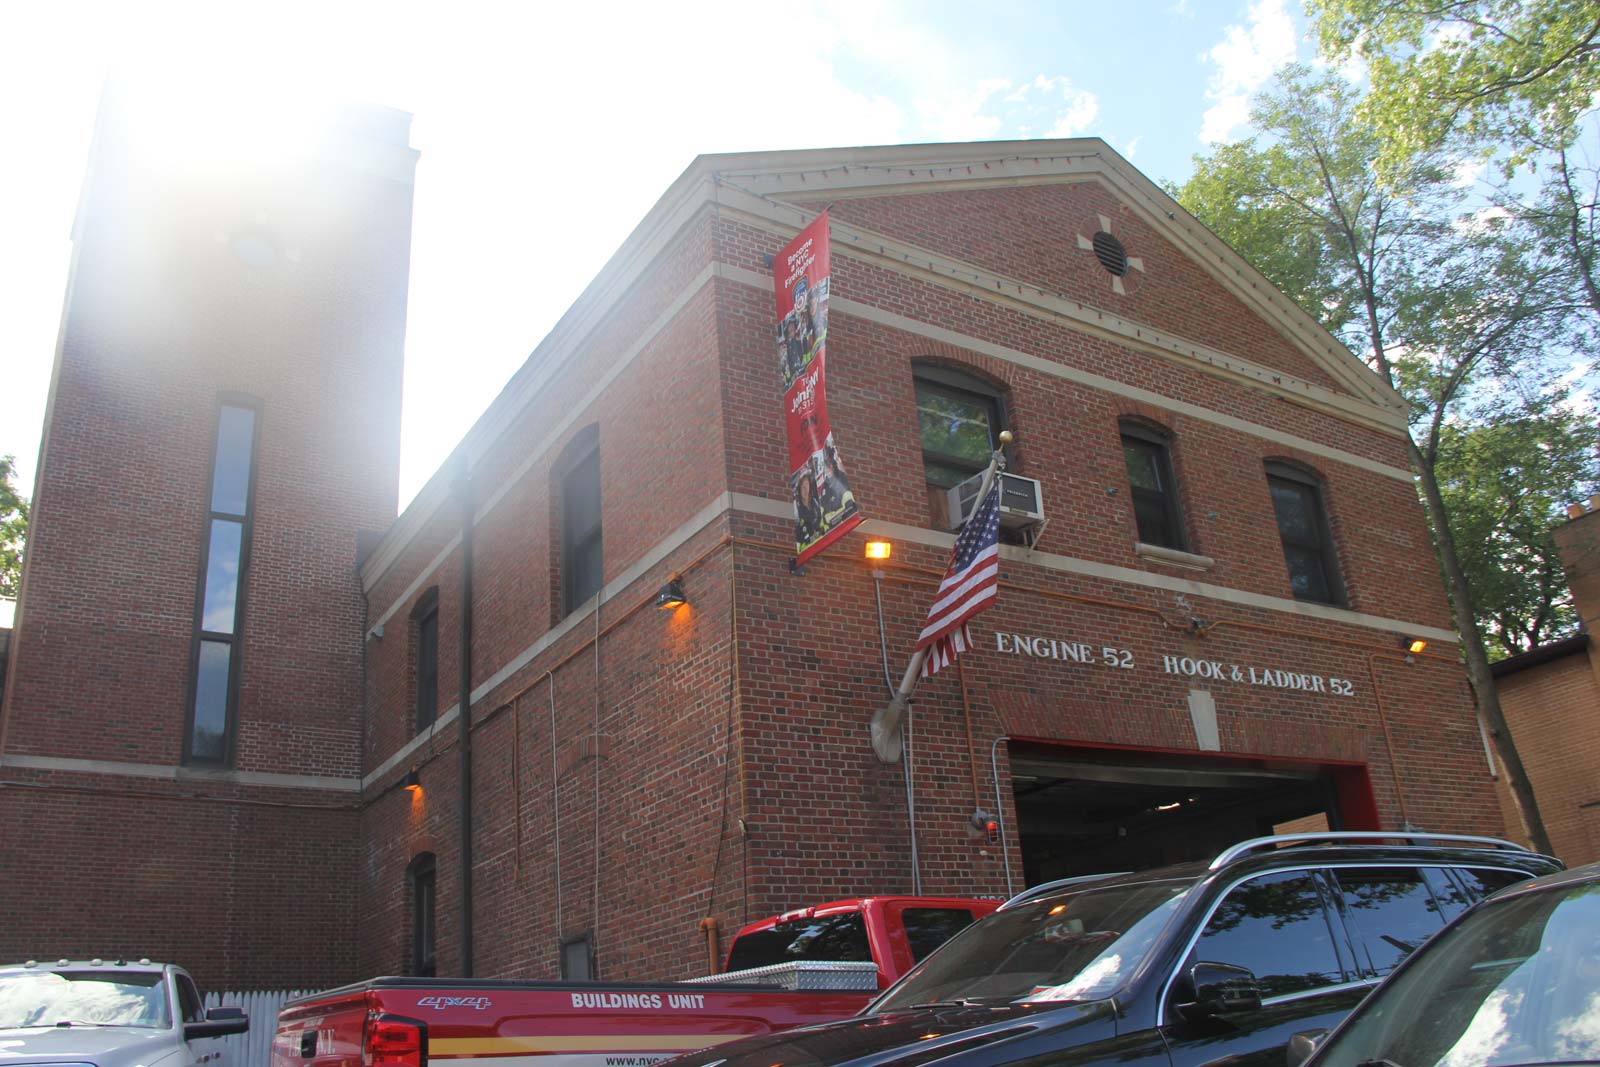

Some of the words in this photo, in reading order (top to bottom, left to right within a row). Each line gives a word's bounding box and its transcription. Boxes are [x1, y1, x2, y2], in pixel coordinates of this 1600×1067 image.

[795, 248, 809, 267] NYC
[995, 631, 1096, 664] ENGINE
[1102, 646, 1135, 669] 52
[1162, 655, 1226, 680] HOOK
[1230, 664, 1244, 683] &
[1249, 667, 1326, 693] LADDER
[1329, 677, 1355, 697] 52
[571, 993, 662, 1009] BUILDINGS
[668, 994, 705, 1009] UNIT
